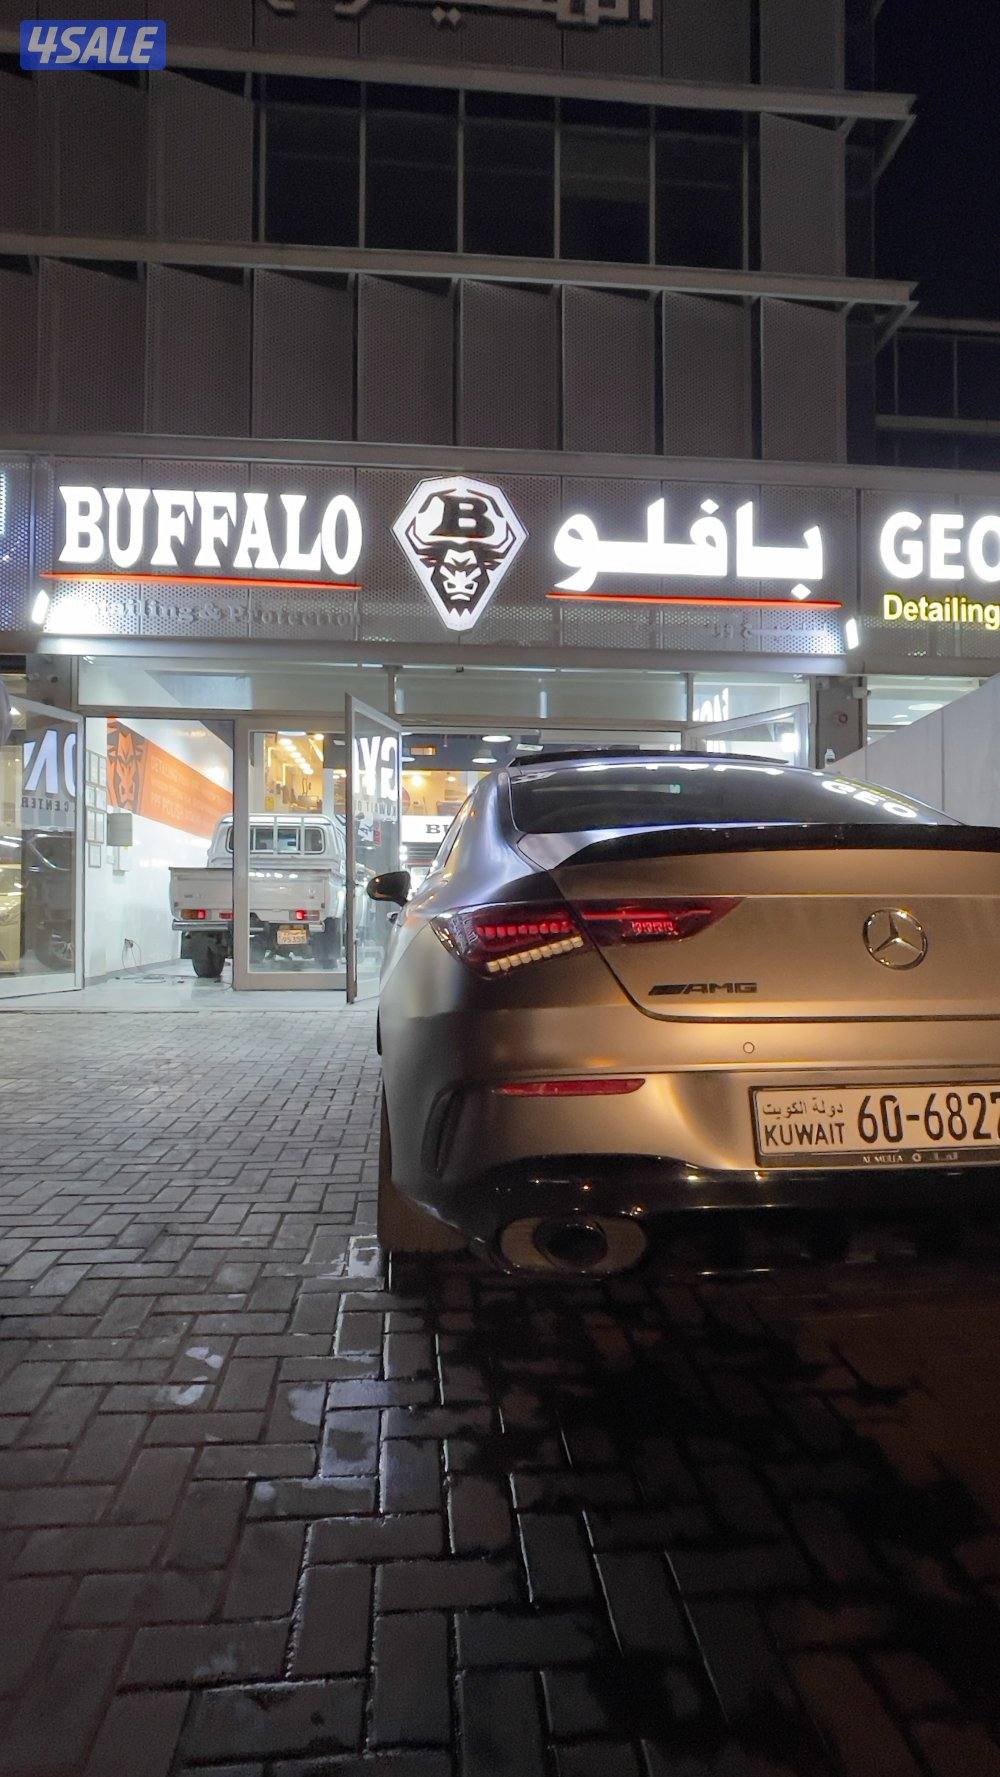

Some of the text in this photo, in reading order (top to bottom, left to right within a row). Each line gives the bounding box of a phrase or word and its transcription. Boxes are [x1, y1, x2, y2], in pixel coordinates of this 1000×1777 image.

[58, 485, 363, 575] BUFFALO
[553, 497, 824, 600] بافلو
[883, 593, 1000, 630] Detailing
[684, 982, 757, 994] AMG
[763, 1097, 845, 1119] دولة الكويت
[764, 1122, 846, 1147] KUWAIT
